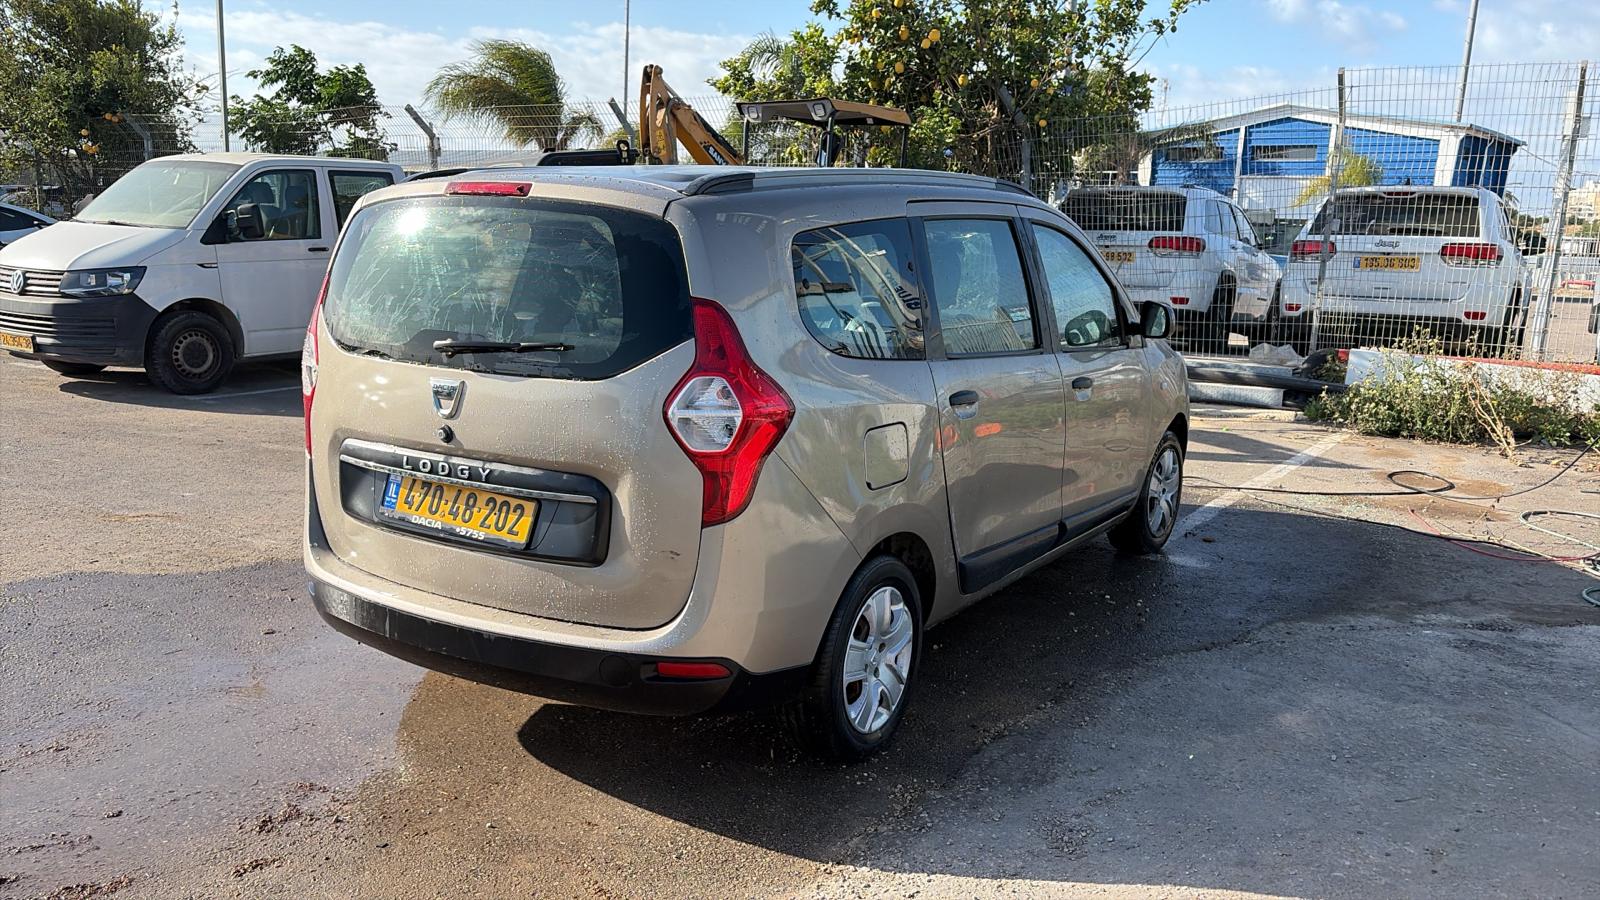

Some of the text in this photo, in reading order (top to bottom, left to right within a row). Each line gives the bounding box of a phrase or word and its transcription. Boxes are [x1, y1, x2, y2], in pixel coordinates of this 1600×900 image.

[1375, 239, 1400, 249] Jeep
[403, 455, 493, 482] LODGY
[388, 482, 398, 498] IL
[411, 515, 442, 530] DACIA
